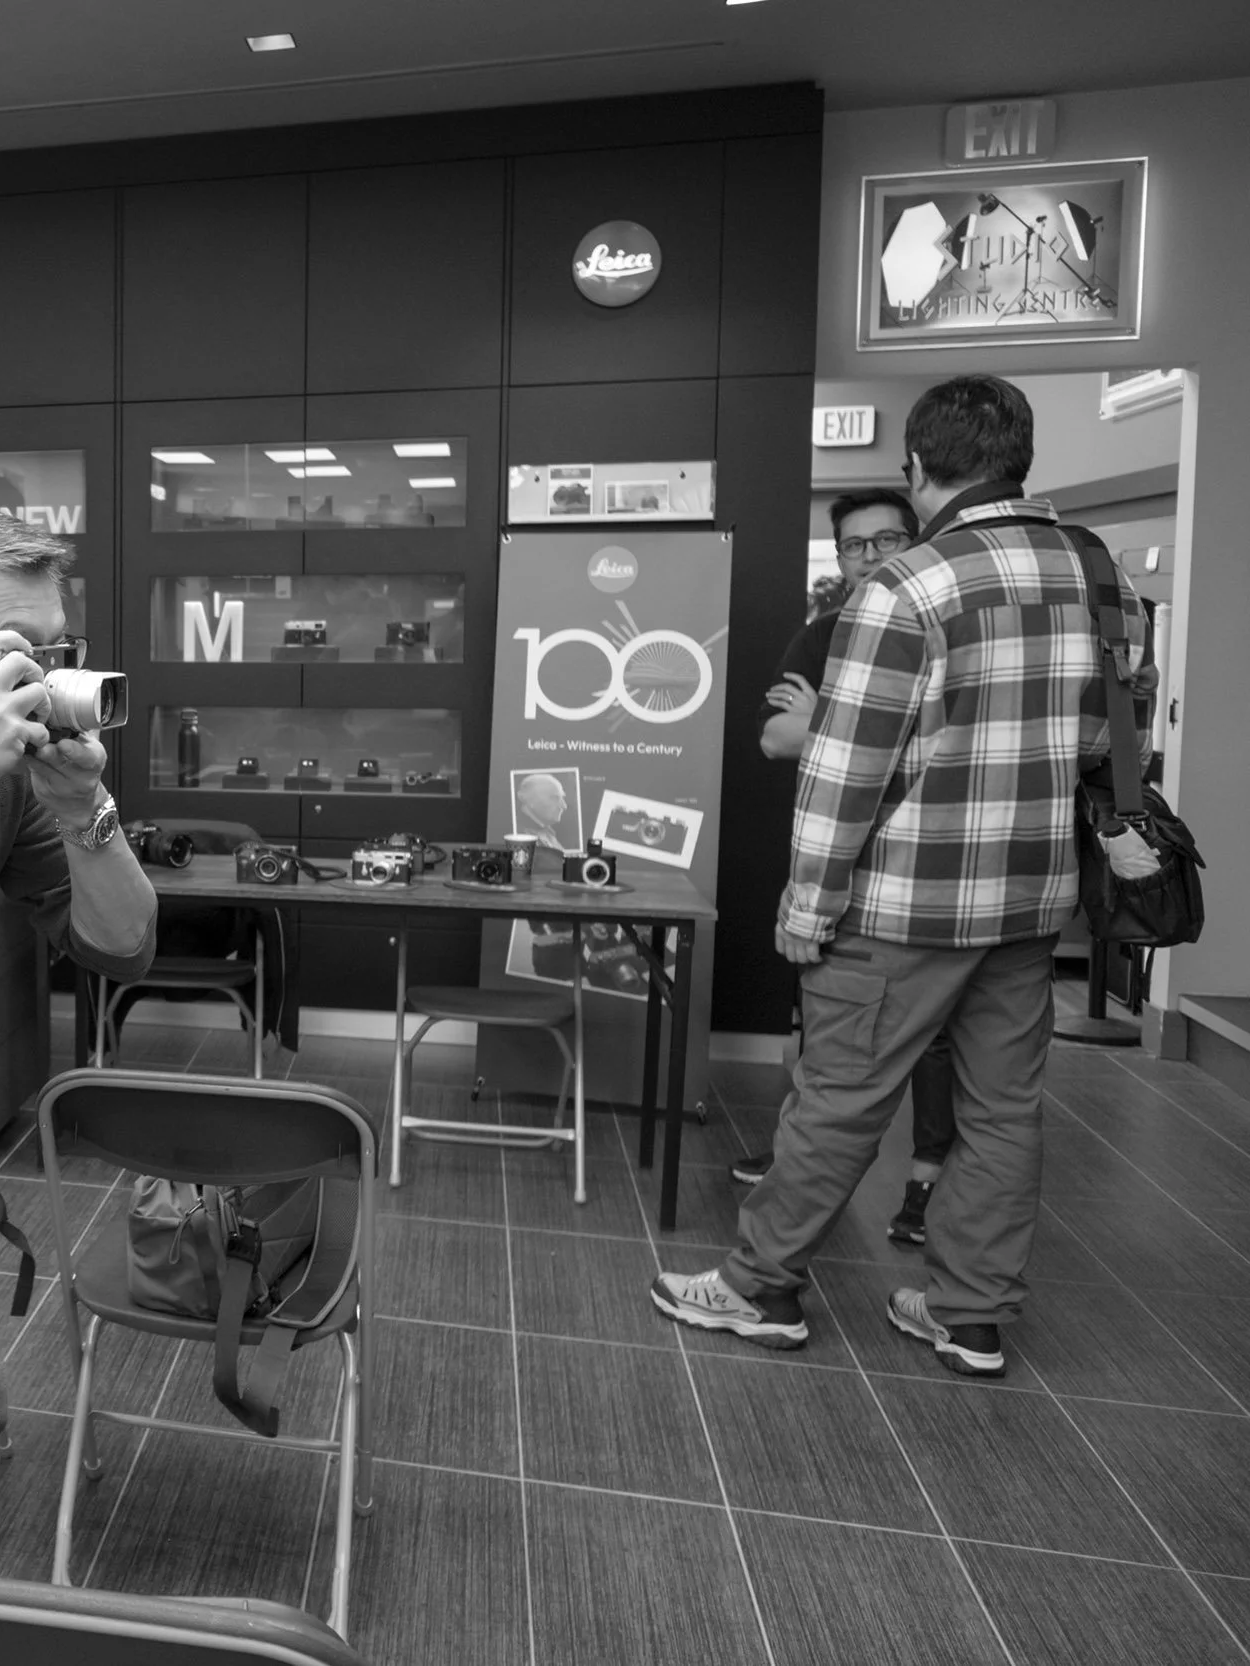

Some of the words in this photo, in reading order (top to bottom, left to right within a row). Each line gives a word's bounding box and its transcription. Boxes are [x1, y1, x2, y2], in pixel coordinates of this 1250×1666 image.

[964, 104, 1045, 159] EXIT
[576, 243, 654, 279] Leica
[933, 224, 1069, 281] STUDIO
[897, 293, 1006, 322] LIGHTING
[823, 410, 867, 441] EXIT
[590, 558, 635, 578] Leica
[182, 600, 244, 662] M
[513, 627, 713, 724] 100
[527, 738, 558, 751] Leica
[566, 739, 611, 753] Witness
[613, 741, 626, 753] to
[627, 745, 636, 754] a
[637, 742, 683, 757] Century
